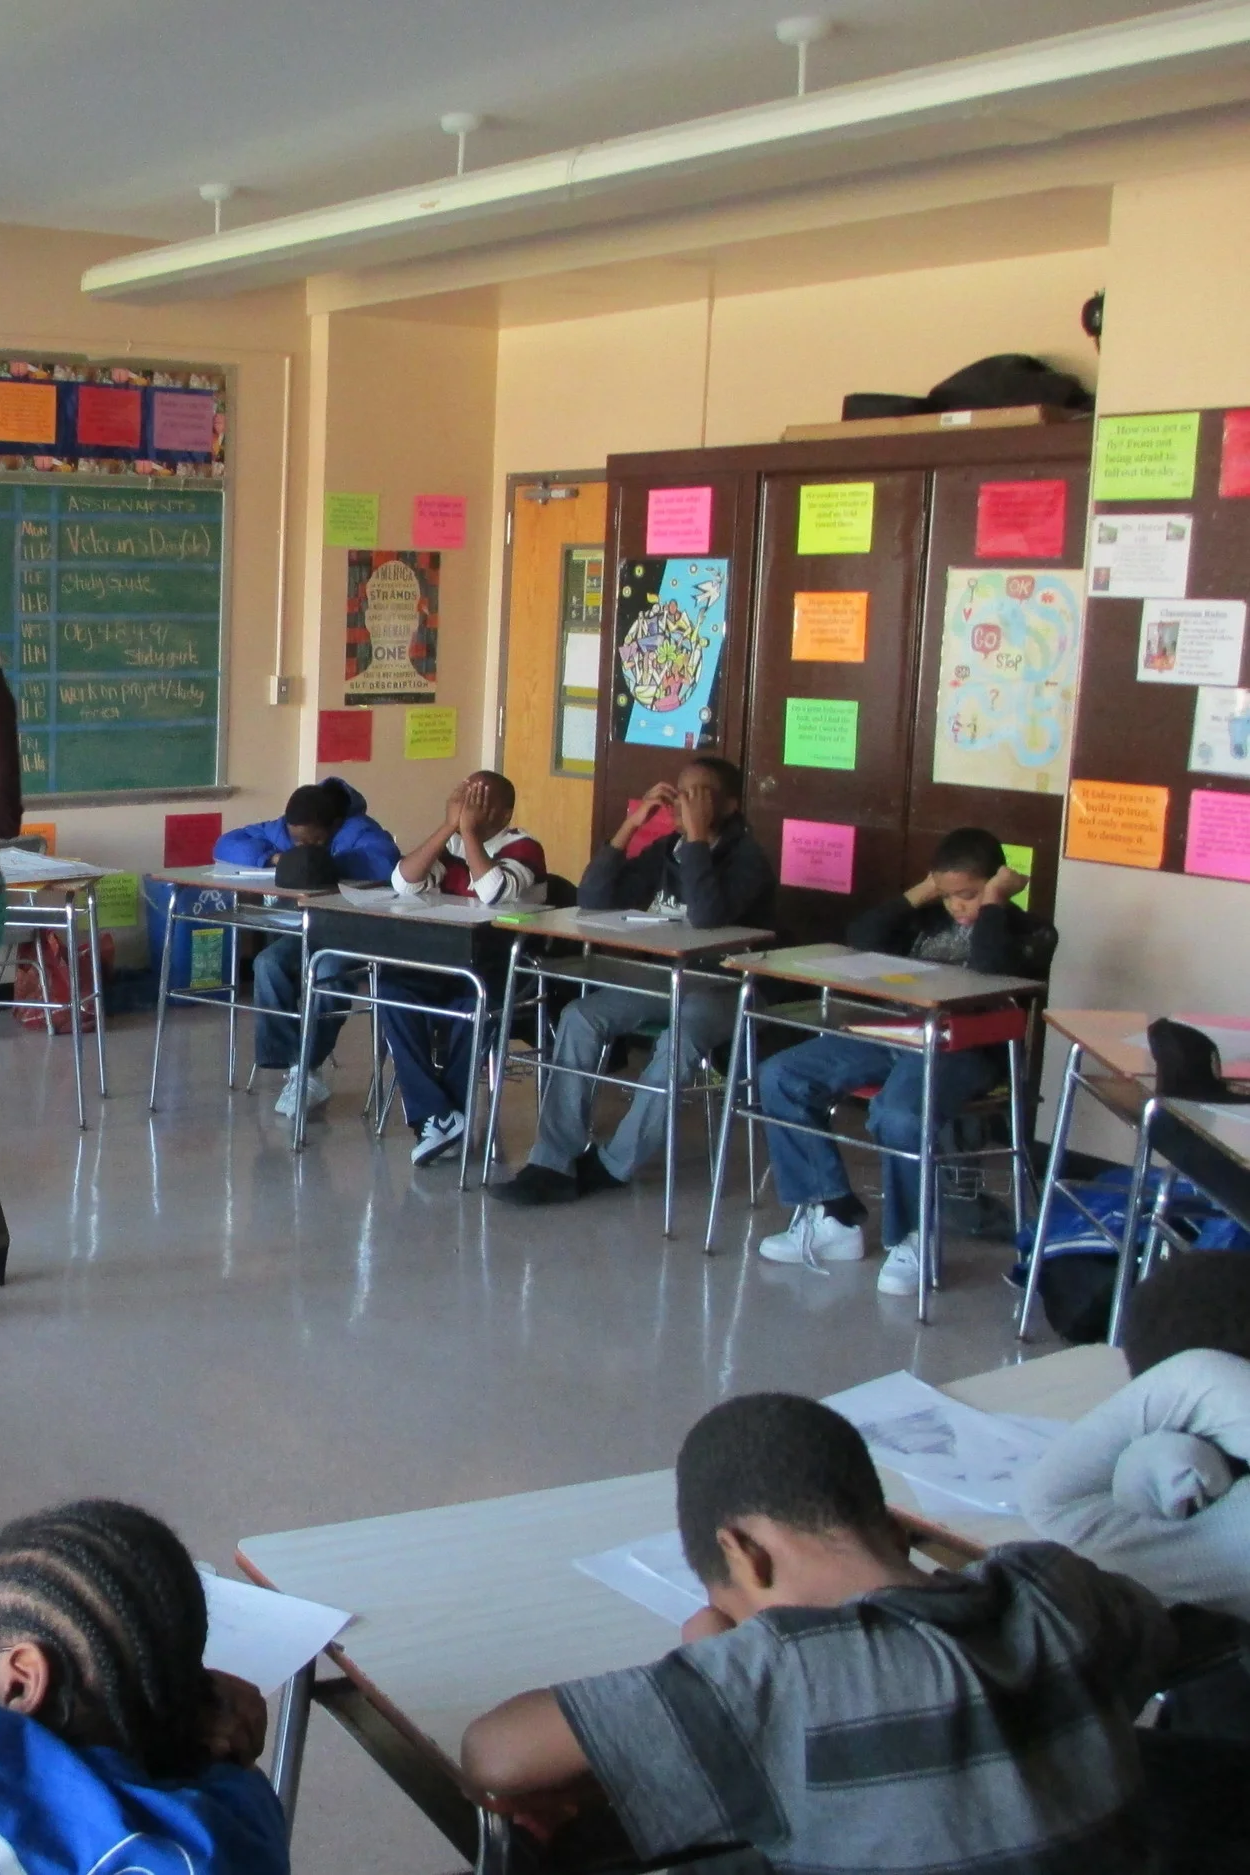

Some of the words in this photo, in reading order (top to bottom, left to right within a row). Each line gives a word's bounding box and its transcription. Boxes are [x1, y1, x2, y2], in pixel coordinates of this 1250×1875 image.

[1141, 426, 1160, 436] you
[1133, 450, 1163, 463] afraid
[1139, 465, 1156, 477] the
[1009, 578, 1031, 595] OK
[370, 589, 417, 601] STRANDS
[974, 630, 998, 648] GO
[373, 645, 407, 661] ONE
[349, 681, 366, 690] BUT
[369, 680, 429, 690] DESCRIPTION
[989, 688, 1000, 712] ?
[1090, 789, 1116, 800] takes
[1117, 792, 1144, 804] years
[1145, 795, 1156, 803] to
[1085, 801, 1111, 813] build
[1111, 805, 1125, 818] up
[1078, 815, 1096, 825] and
[1097, 817, 1118, 830] only
[1087, 829, 1097, 839] to
[1099, 830, 1134, 846] destroy
